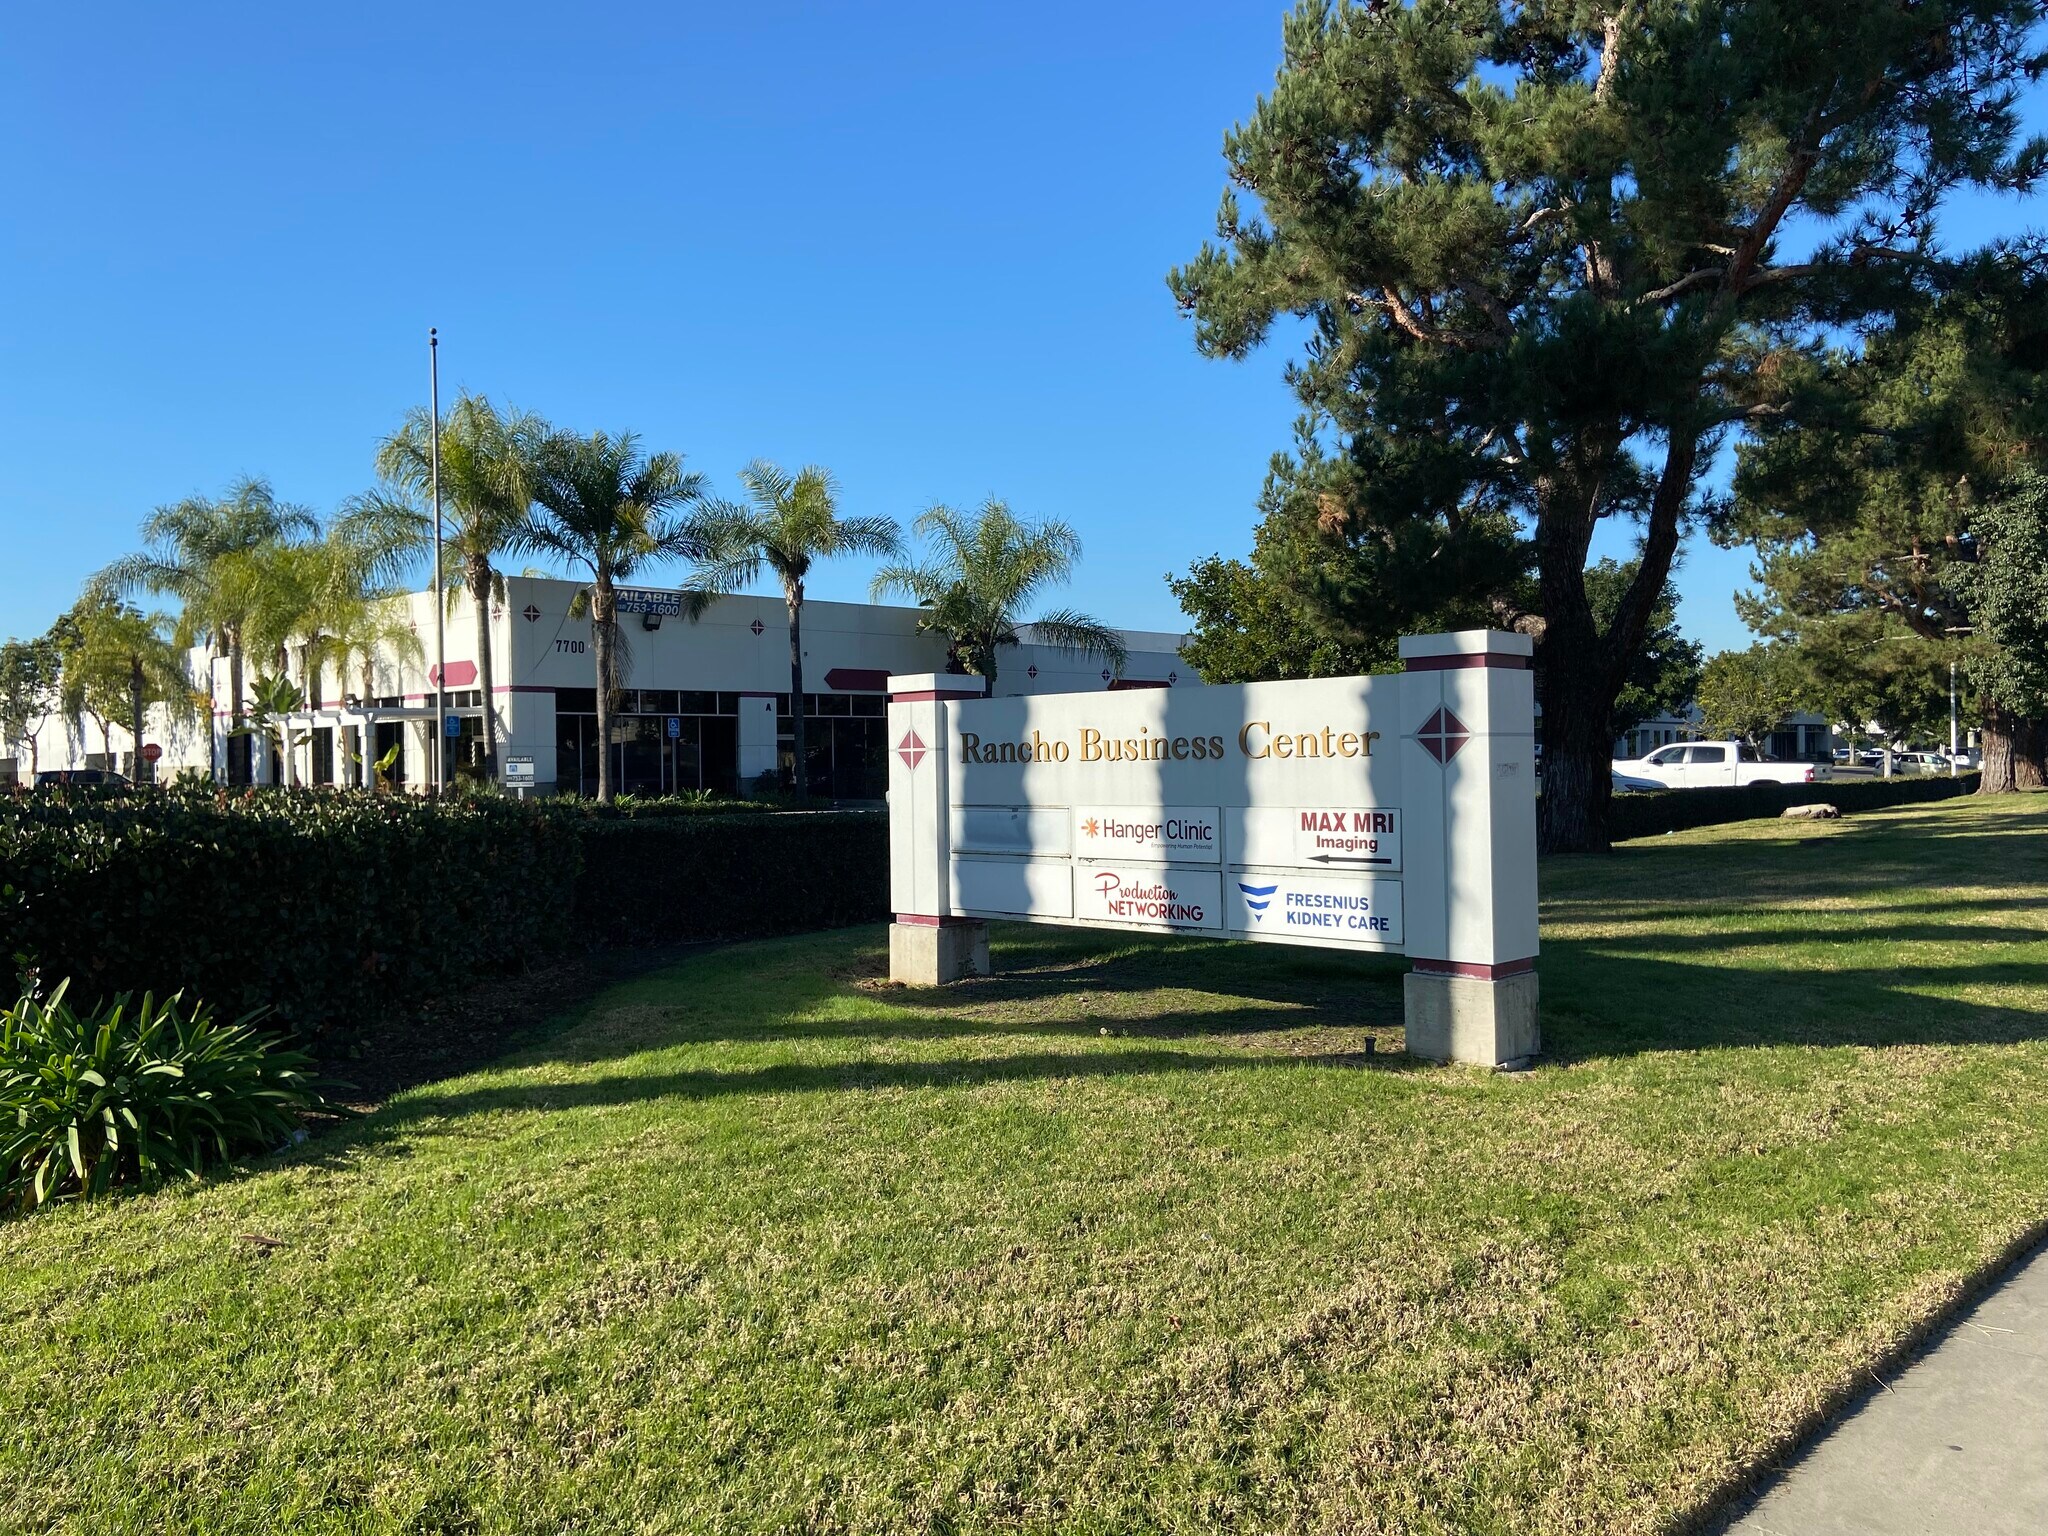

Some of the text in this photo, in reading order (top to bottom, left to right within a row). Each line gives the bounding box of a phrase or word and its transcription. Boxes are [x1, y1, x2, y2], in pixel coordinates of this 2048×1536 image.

[616, 590, 680, 605] AILABLE
[626, 602, 679, 616] 753-1600
[556, 639, 585, 654] 7700
[765, 702, 772, 712] A
[960, 721, 1381, 764] Rancho Business Center
[143, 747, 161, 757] STOP
[1103, 818, 1213, 844] Hanger Clinic
[1301, 812, 1394, 833] MAX MRI
[1316, 835, 1379, 853] Imaging
[1094, 872, 1179, 900] Production
[1108, 900, 1204, 922] NETWORKING
[1286, 893, 1369, 911] FRESENIUS
[1287, 911, 1390, 932] KIDNEY CARE
